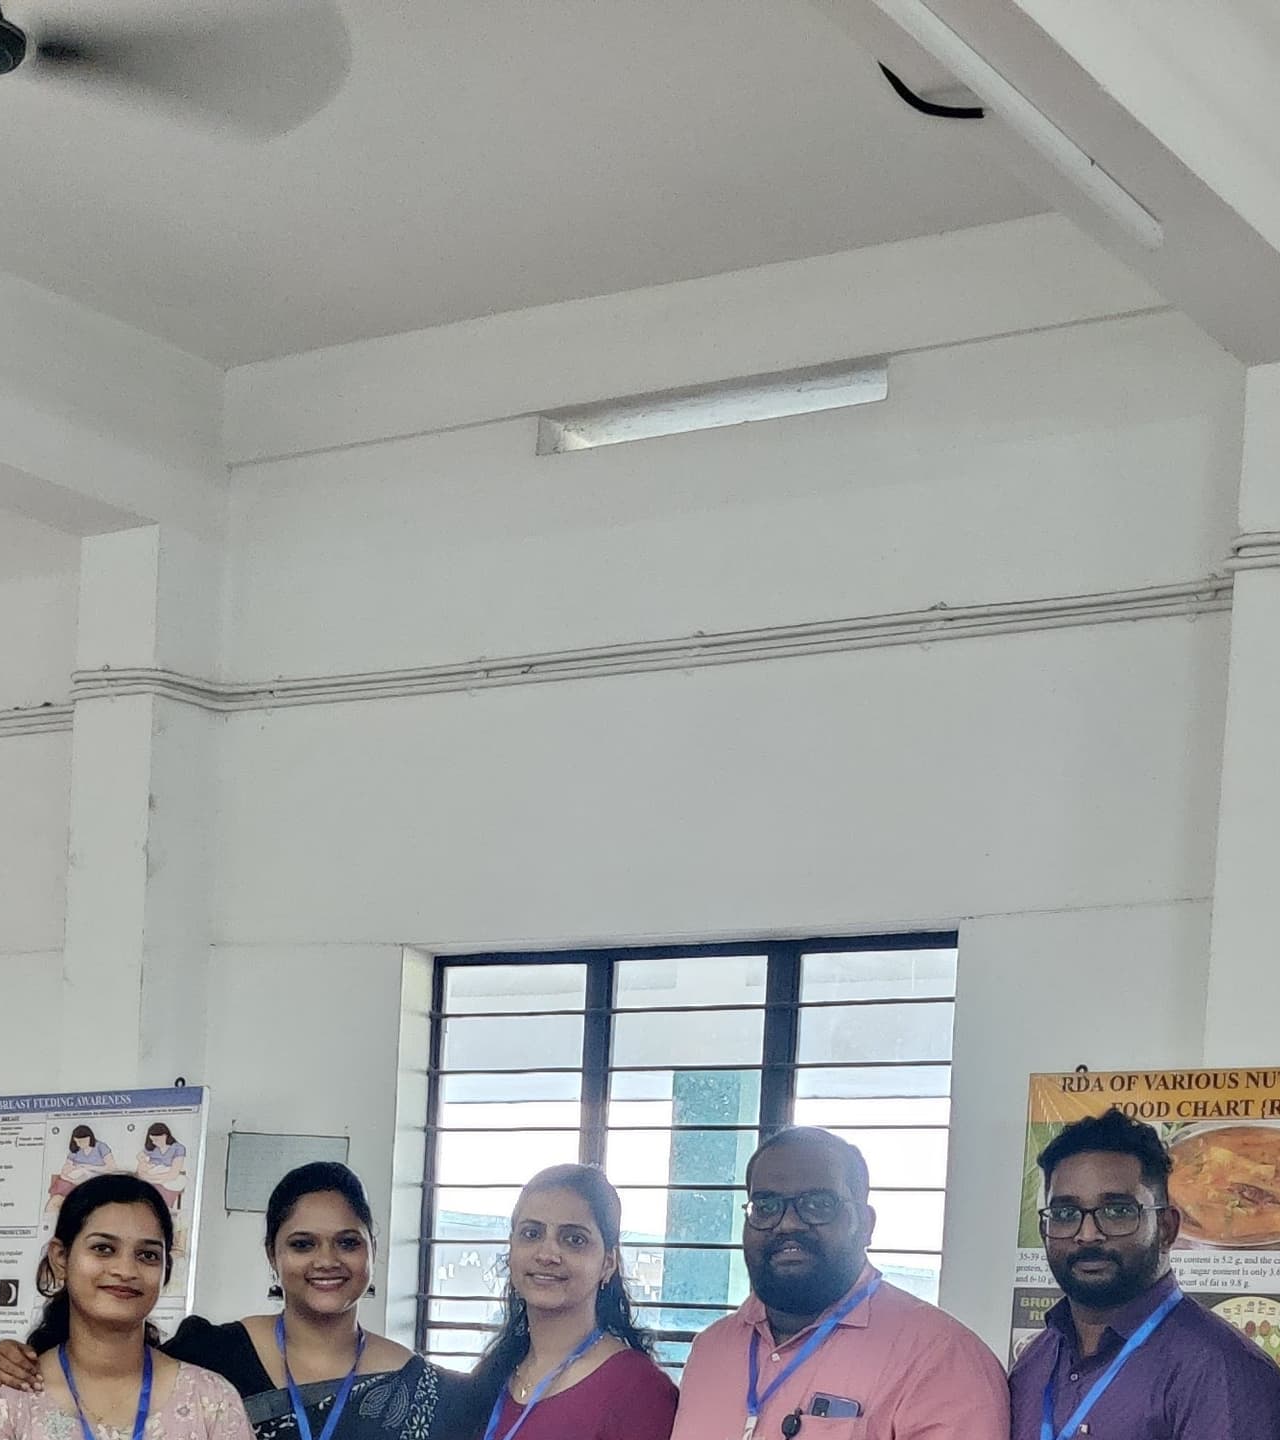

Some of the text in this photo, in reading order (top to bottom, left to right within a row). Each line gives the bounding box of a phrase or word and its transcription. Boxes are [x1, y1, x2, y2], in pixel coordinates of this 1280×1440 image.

[1062, 1075, 1105, 1093] RDA
[1109, 1074, 1139, 1092] OF
[1143, 1072, 1240, 1091] VARIOUS
[33, 1096, 74, 1108] FEEDING
[76, 1093, 132, 1107] AWARENESS
[1176, 1099, 1256, 1118] CHART
[1250, 1267, 1267, 1277] only
